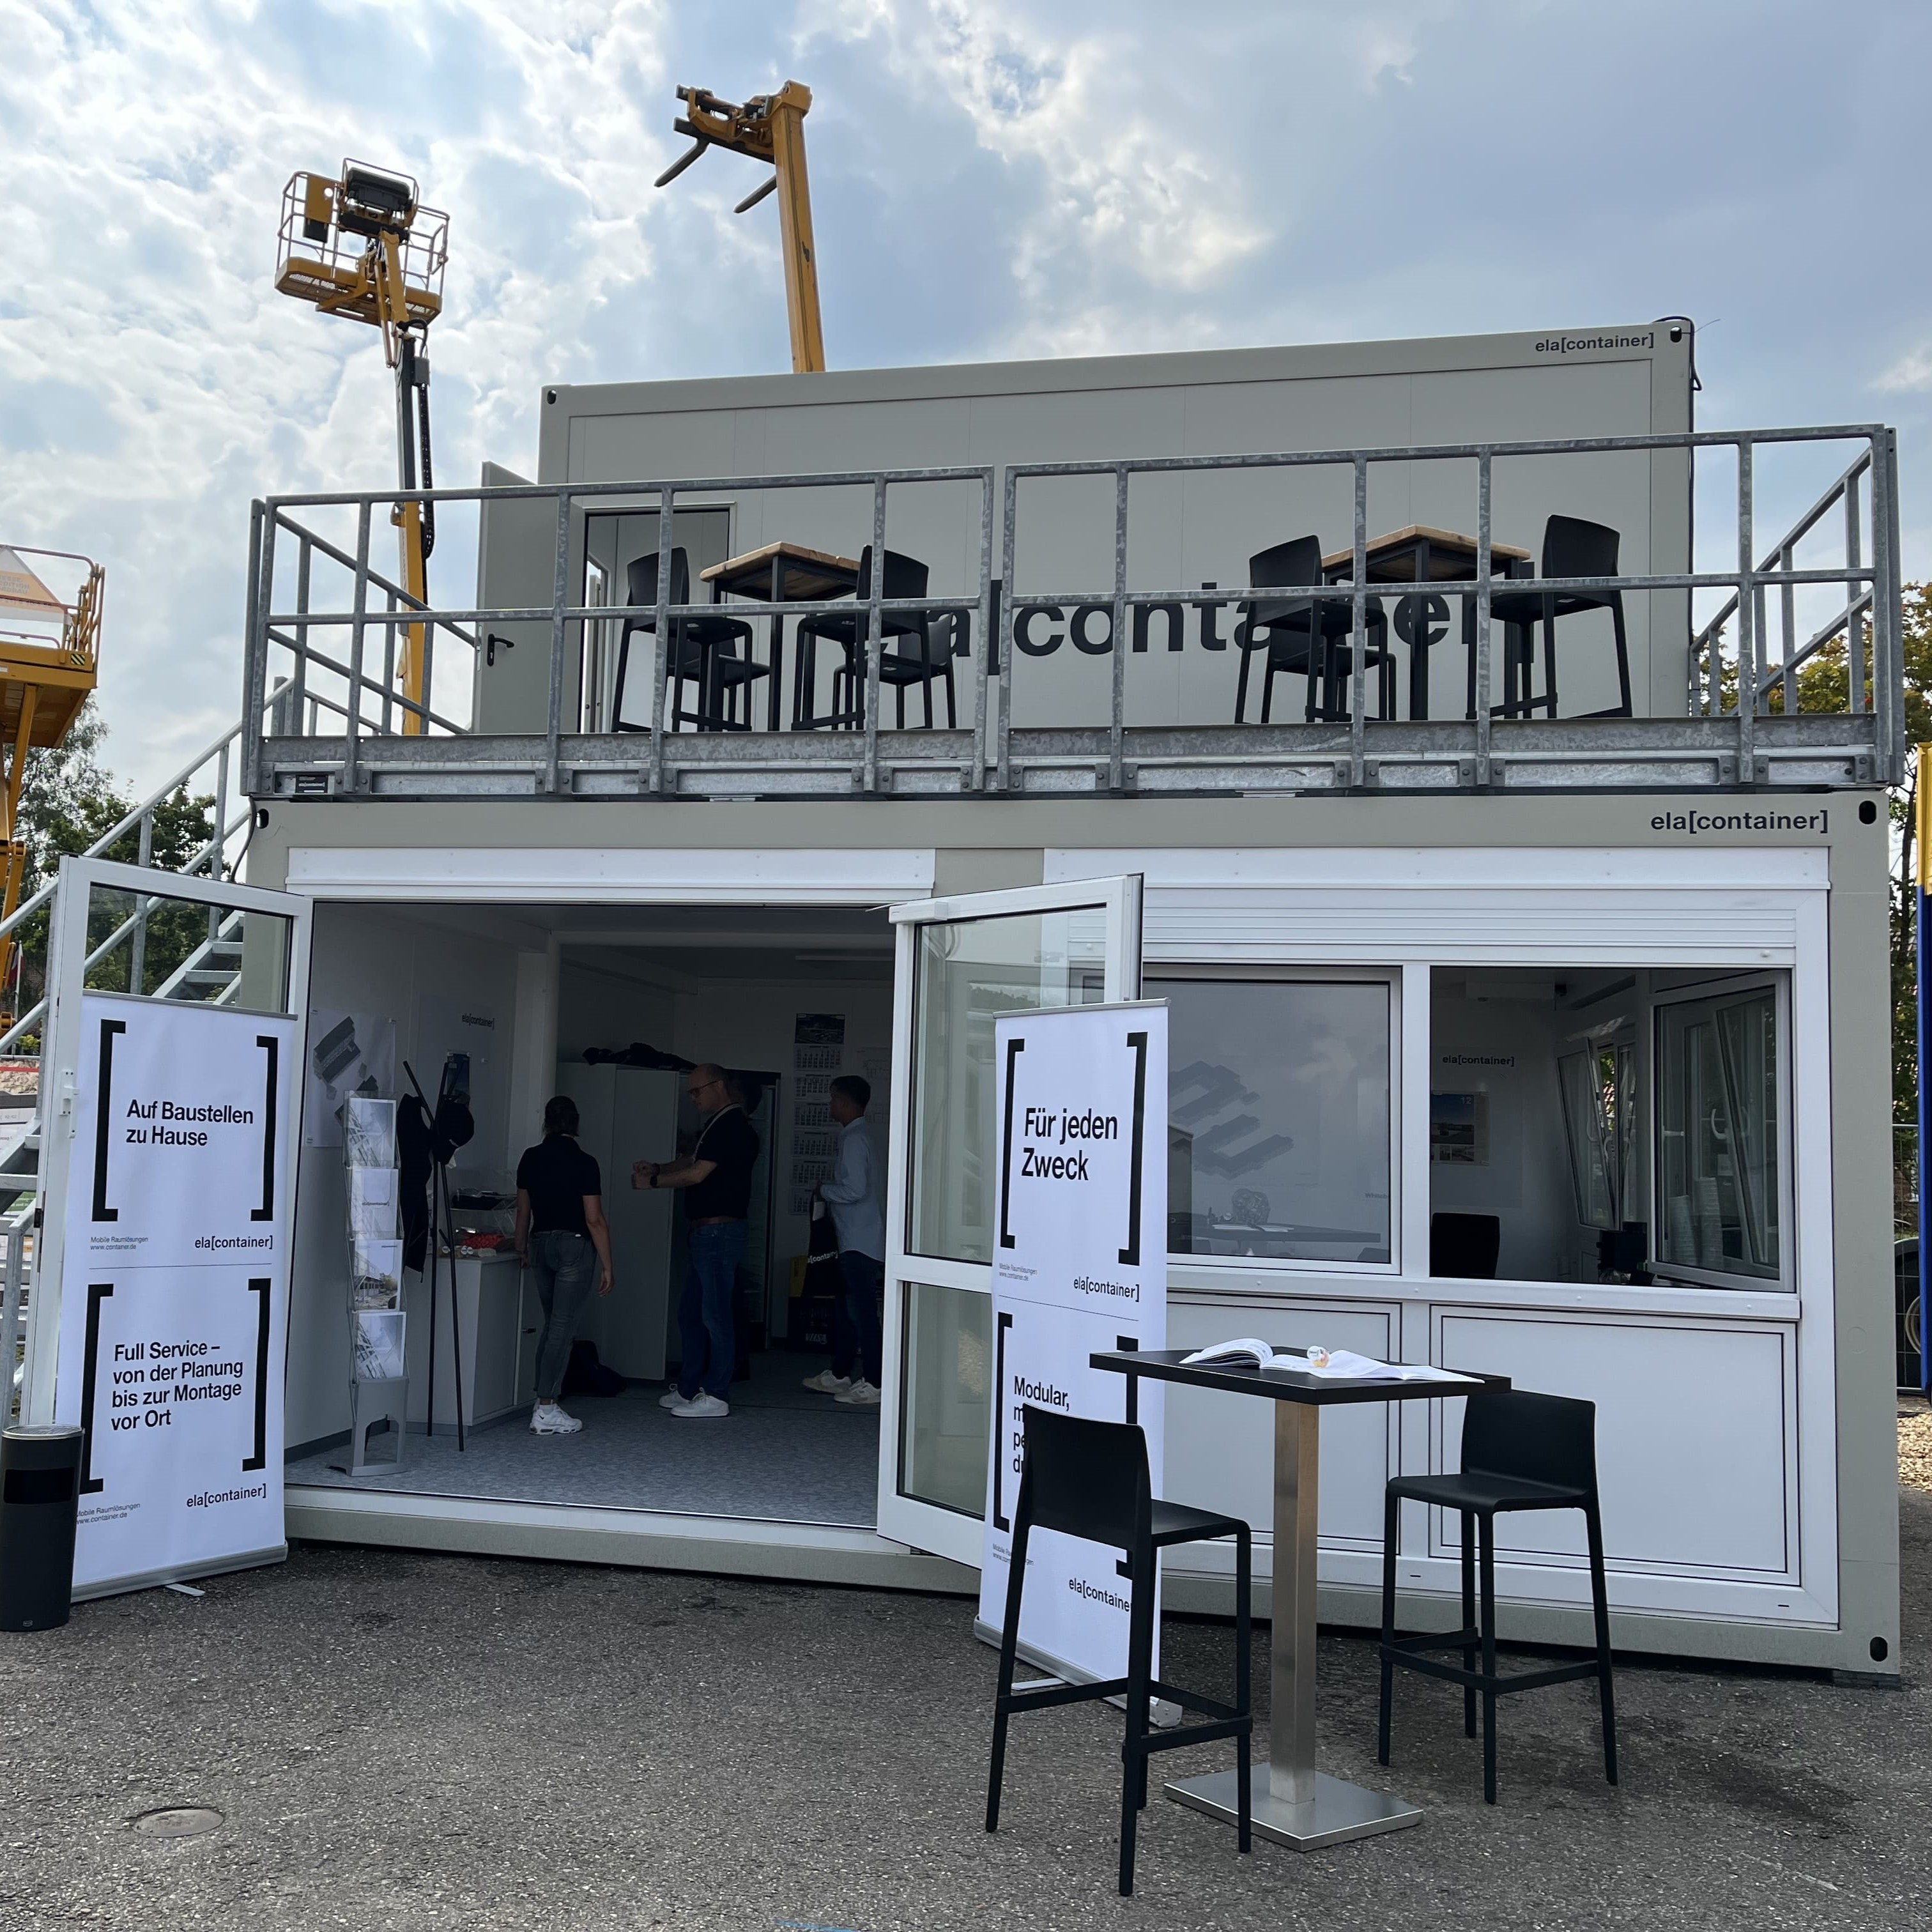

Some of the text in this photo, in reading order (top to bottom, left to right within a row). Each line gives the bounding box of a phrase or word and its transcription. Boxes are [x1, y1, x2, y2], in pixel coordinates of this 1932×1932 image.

[1535, 332, 1654, 353] ela[container]
[1650, 809, 1828, 834] ela[container]
[1442, 1054, 1515, 1068] ela[container]
[126, 1099, 254, 1124] Auf Baustellen
[1459, 1096, 1473, 1105] 12
[126, 1125, 208, 1146] zu Hause
[1024, 1107, 1117, 1145] Für jeden
[1022, 1147, 1089, 1181] Zweck
[194, 1235, 273, 1251] ela[container]
[1073, 1276, 1140, 1303] ela[container]
[114, 1342, 144, 1361] Full
[149, 1340, 208, 1360] Service
[113, 1361, 243, 1384] von der Planung
[112, 1383, 241, 1408] bis zur Montage
[1014, 1376, 1070, 1412] Modular,
[111, 1409, 171, 1431] vor Ort
[187, 1483, 266, 1508] ela[container]
[96, 1503, 141, 1514] Raumlösungen
[1069, 1577, 1130, 1613] ela[containe
